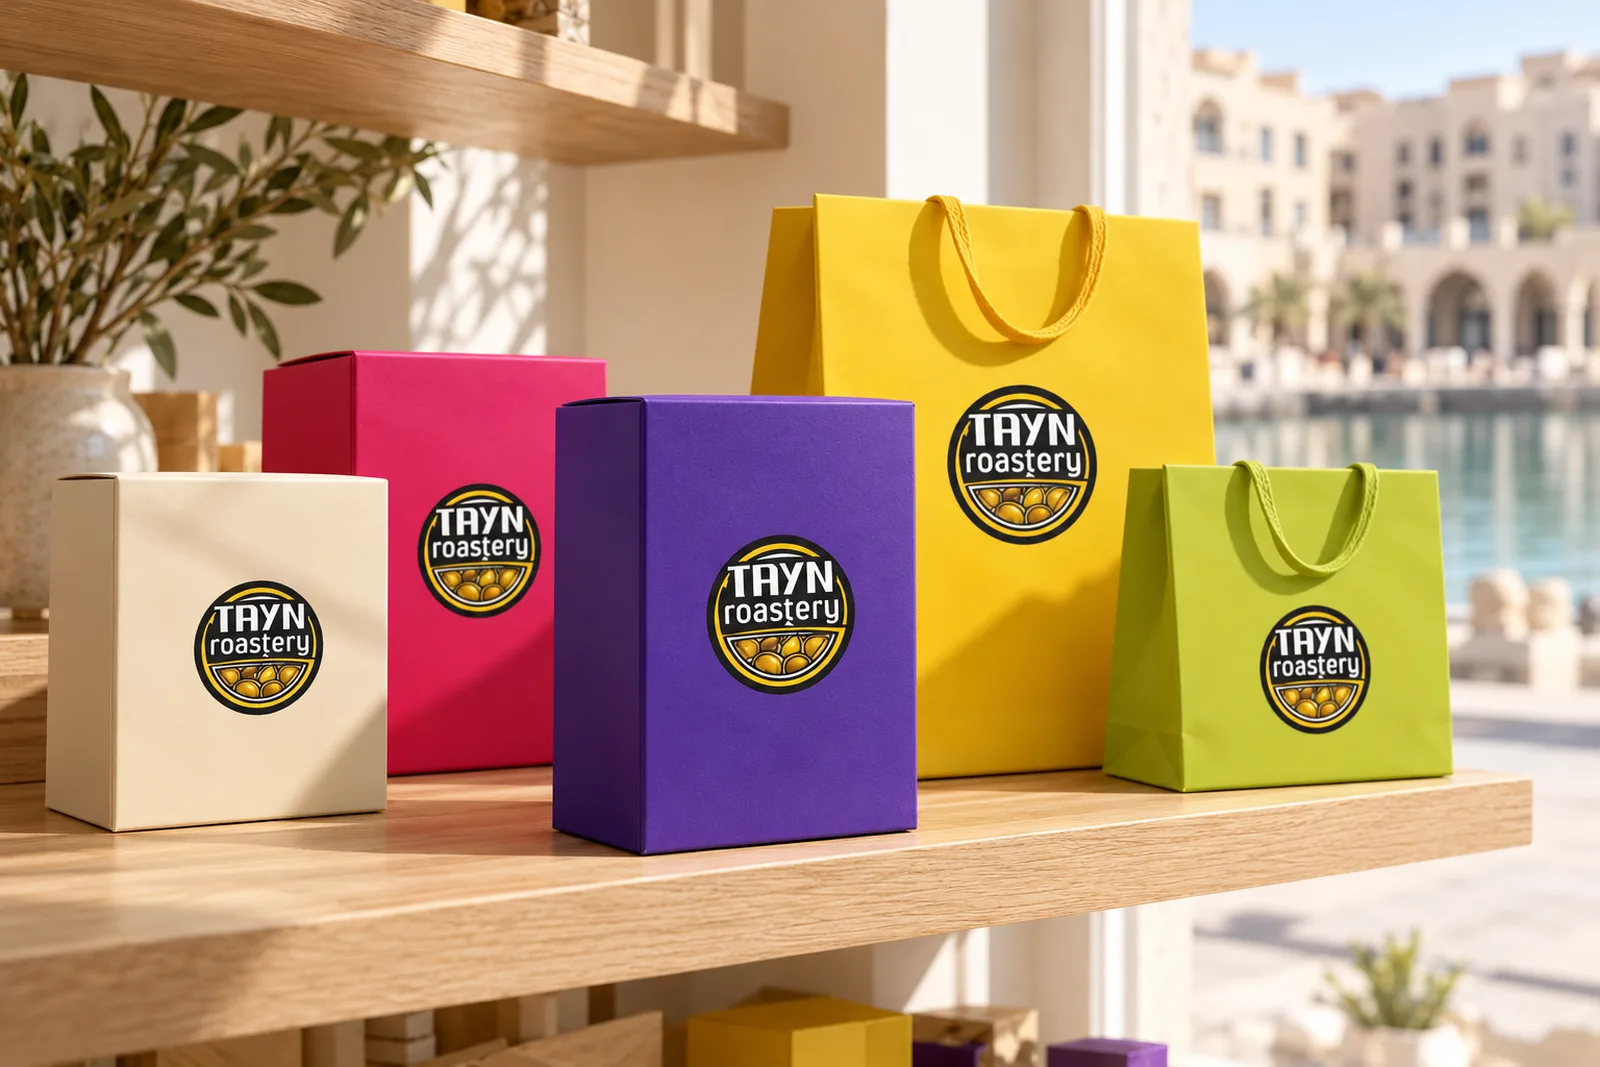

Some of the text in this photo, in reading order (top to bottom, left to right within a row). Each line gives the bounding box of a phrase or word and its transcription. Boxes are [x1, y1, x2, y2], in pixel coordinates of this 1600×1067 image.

[967, 412, 1076, 447] TAYN
[965, 445, 1082, 478] roastery
[435, 505, 524, 537] TAYN
[431, 534, 529, 562] roastery
[727, 560, 834, 597] TAYN
[213, 602, 305, 633] TAYN
[723, 594, 840, 627] roastery
[209, 631, 310, 660] roastery
[1274, 625, 1355, 656] TAYN
[1272, 653, 1360, 679] roastery
